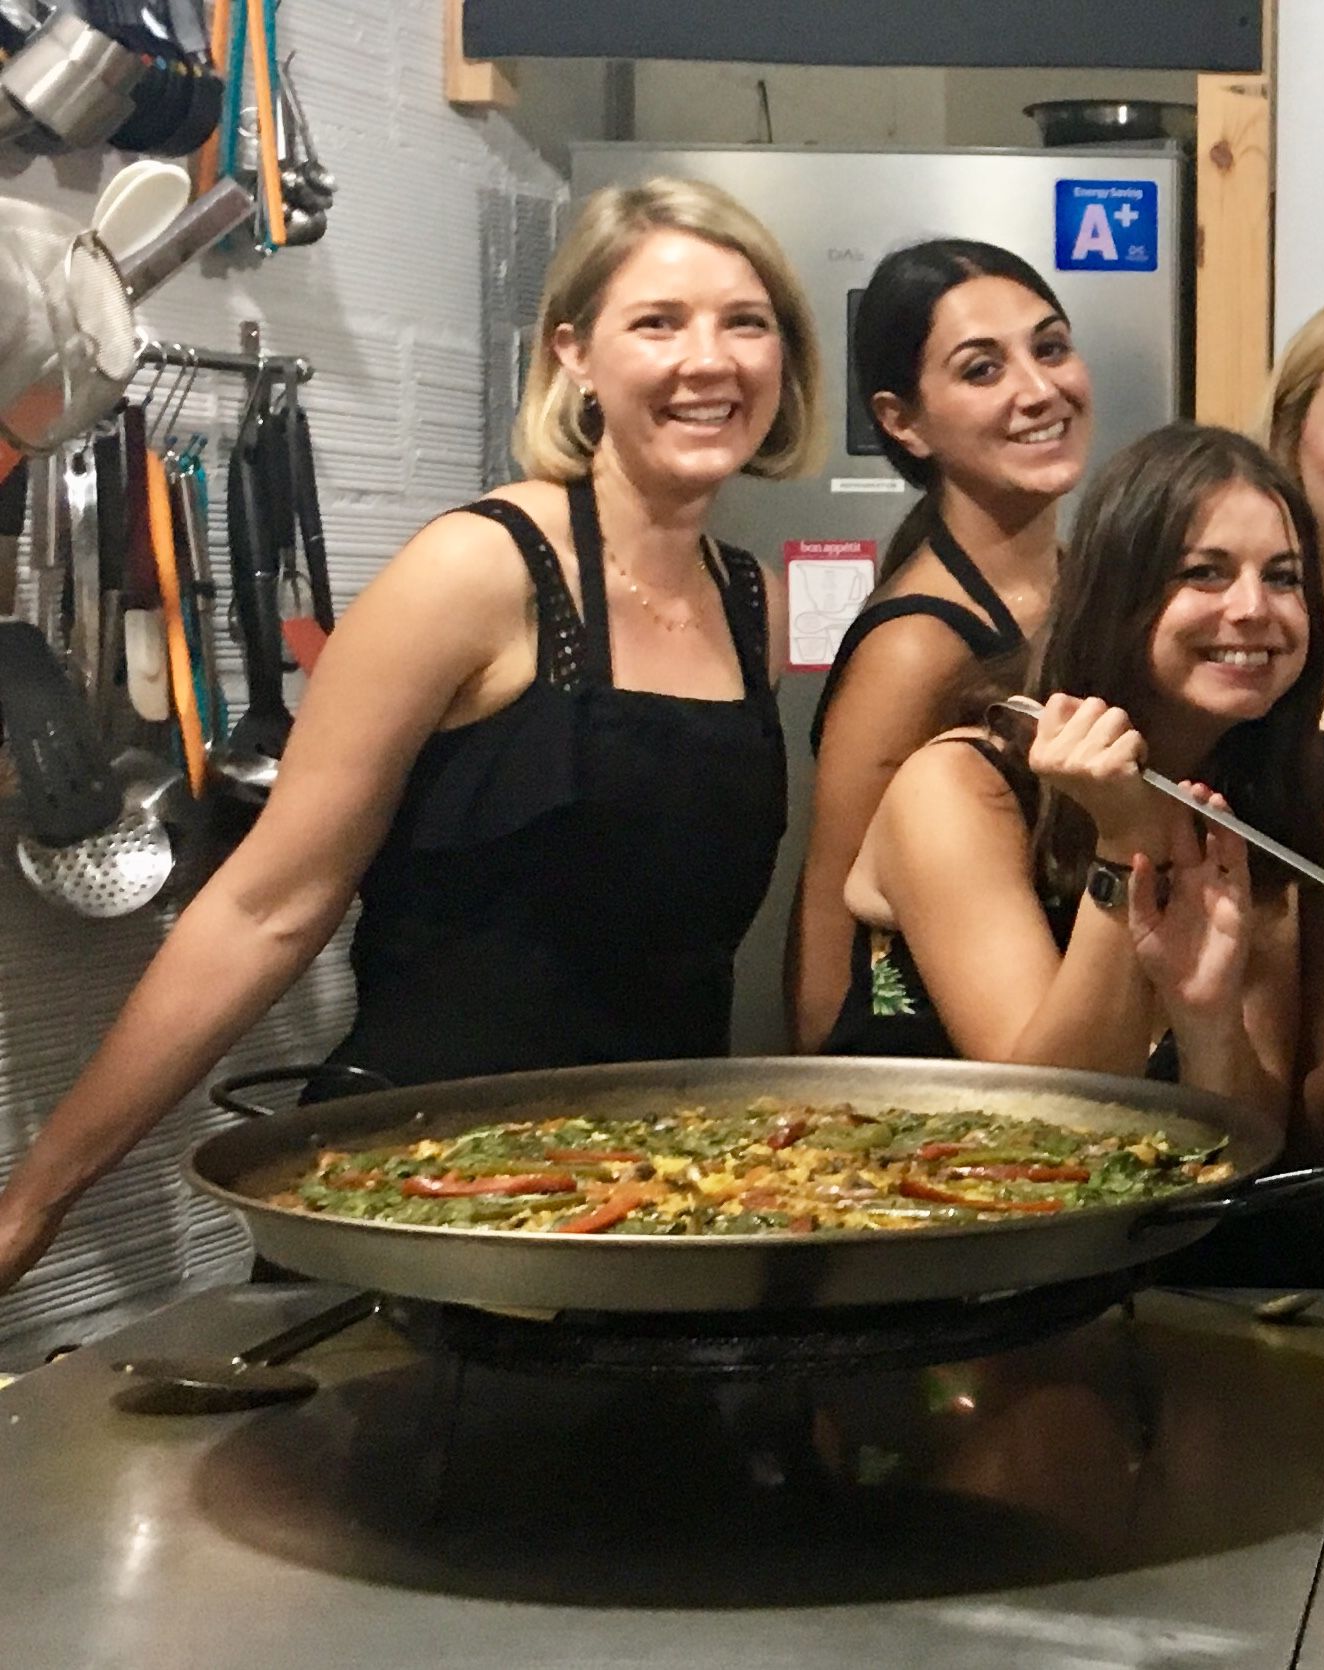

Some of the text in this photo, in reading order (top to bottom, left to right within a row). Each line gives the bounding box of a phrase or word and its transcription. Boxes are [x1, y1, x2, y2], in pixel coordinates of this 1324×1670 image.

[1074, 187, 1144, 200] Energy Saving
[800, 540, 822, 553] bon
